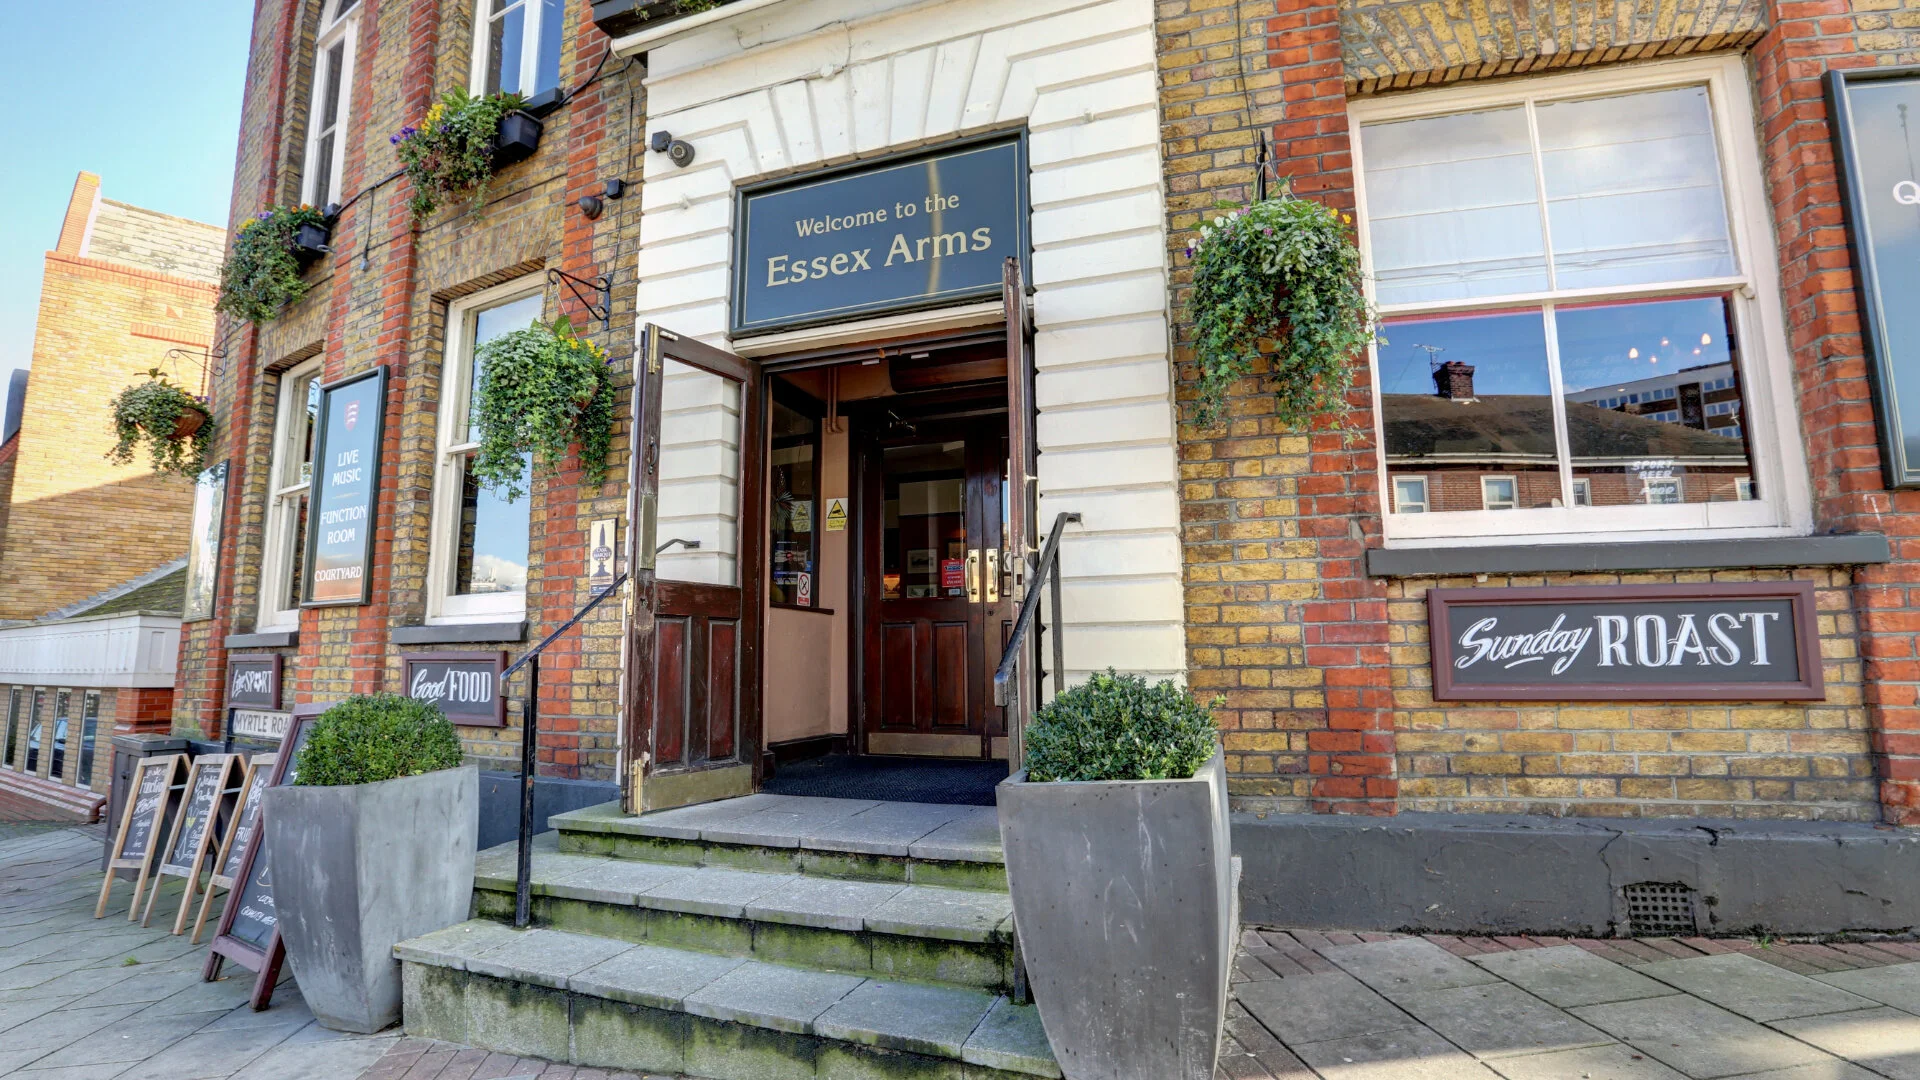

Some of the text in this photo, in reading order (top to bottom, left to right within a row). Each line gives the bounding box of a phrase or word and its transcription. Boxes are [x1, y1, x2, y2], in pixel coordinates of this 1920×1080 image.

[796, 193, 960, 238] Welcome to the
[766, 227, 992, 288] Essex Arms
[338, 449, 359, 467] LIVE
[332, 468, 362, 487] MUSIC
[320, 505, 367, 525] FUNCTION
[327, 528, 356, 545] ROOM
[314, 565, 362, 583] COURTYARD
[1454, 612, 1778, 676] Sunday ROAST
[411, 667, 492, 702] Good FOOD
[235, 715, 289, 734] MYRTLE ROA
